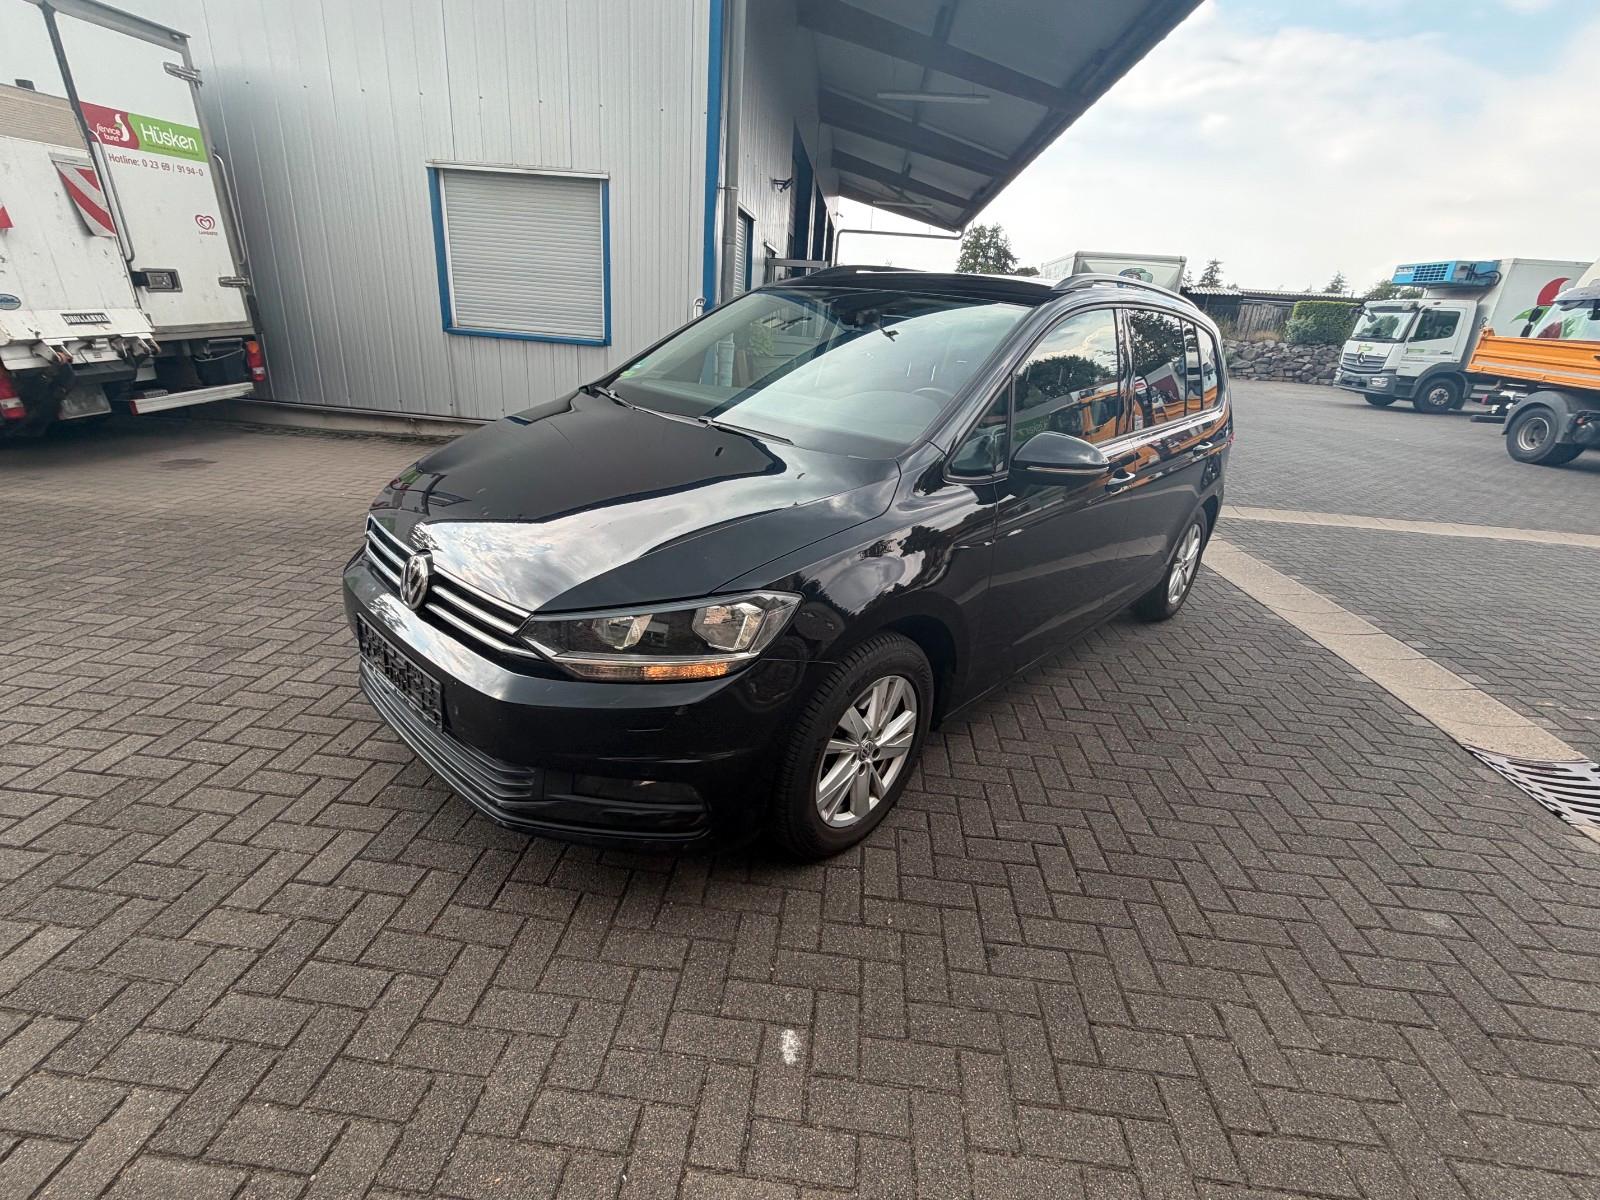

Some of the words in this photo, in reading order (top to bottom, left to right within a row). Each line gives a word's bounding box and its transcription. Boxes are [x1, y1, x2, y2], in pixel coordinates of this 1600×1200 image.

[140, 123, 198, 152] Hüsken
[108, 153, 140, 167] Hotline:
[141, 159, 148, 168] 0
[149, 160, 159, 169] 23
